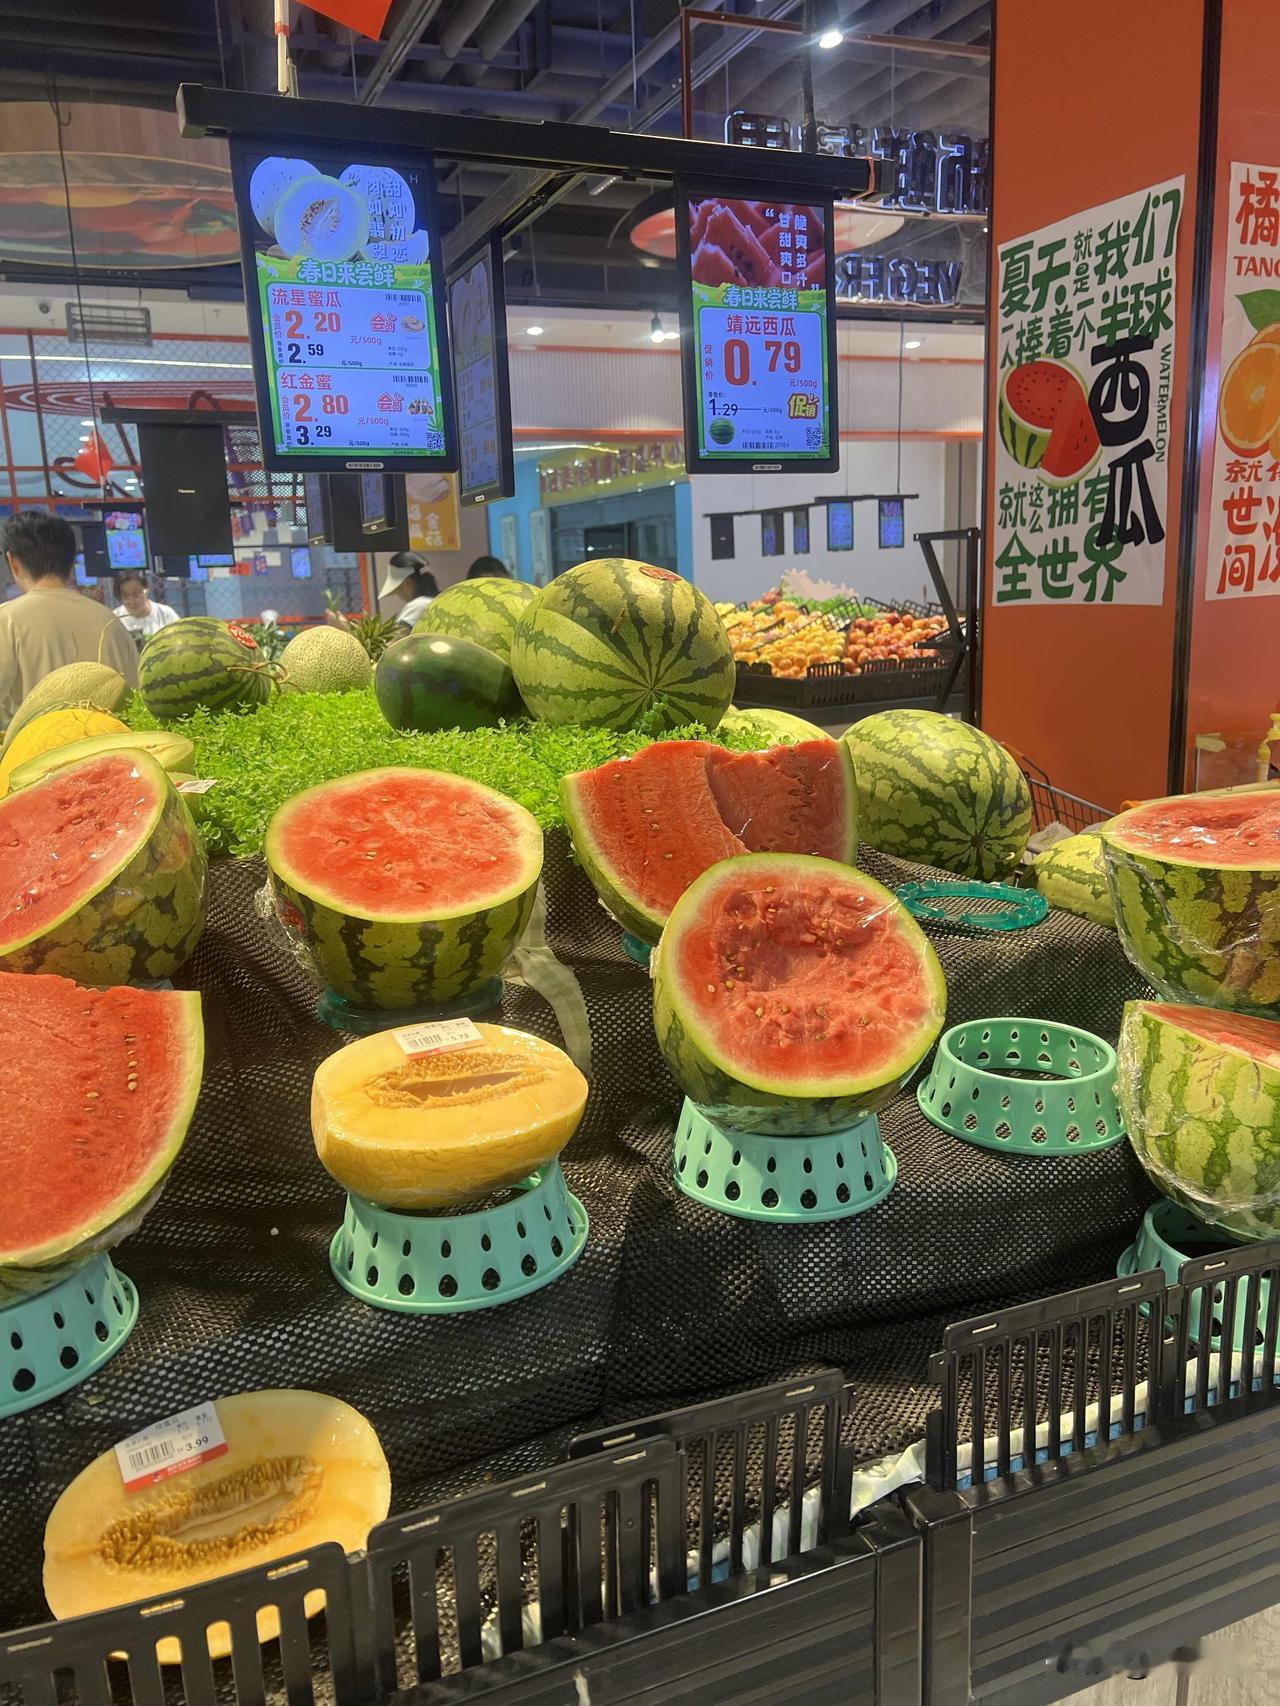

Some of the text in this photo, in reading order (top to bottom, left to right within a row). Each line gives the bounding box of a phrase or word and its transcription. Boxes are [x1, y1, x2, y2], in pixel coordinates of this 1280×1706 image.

[778, 212, 792, 285] 甘甜爽口
[794, 214, 808, 288] 脆爽多汁
[298, 260, 394, 288] 春日来尝鲜
[272, 288, 342, 308] 流星蜜瓜
[724, 287, 798, 310] 春日来尝鲜
[727, 315, 796, 336] 靖远西瓜
[350, 336, 382, 345] 元/500g
[288, 343, 324, 364] 2.59
[704, 344, 713, 381] 促销价
[724, 339, 801, 387] 0.79
[280, 373, 331, 391] 红金蜜
[789, 379, 818, 389] 元/500g
[1156, 343, 1173, 463] WATERMELON
[358, 417, 389, 426] 元/500g
[296, 425, 332, 446] 3.29
[1089, 334, 1165, 547] 西瓜
[995, 522, 1128, 603] 全世界
[186, 1435, 209, 1452] 3.99
